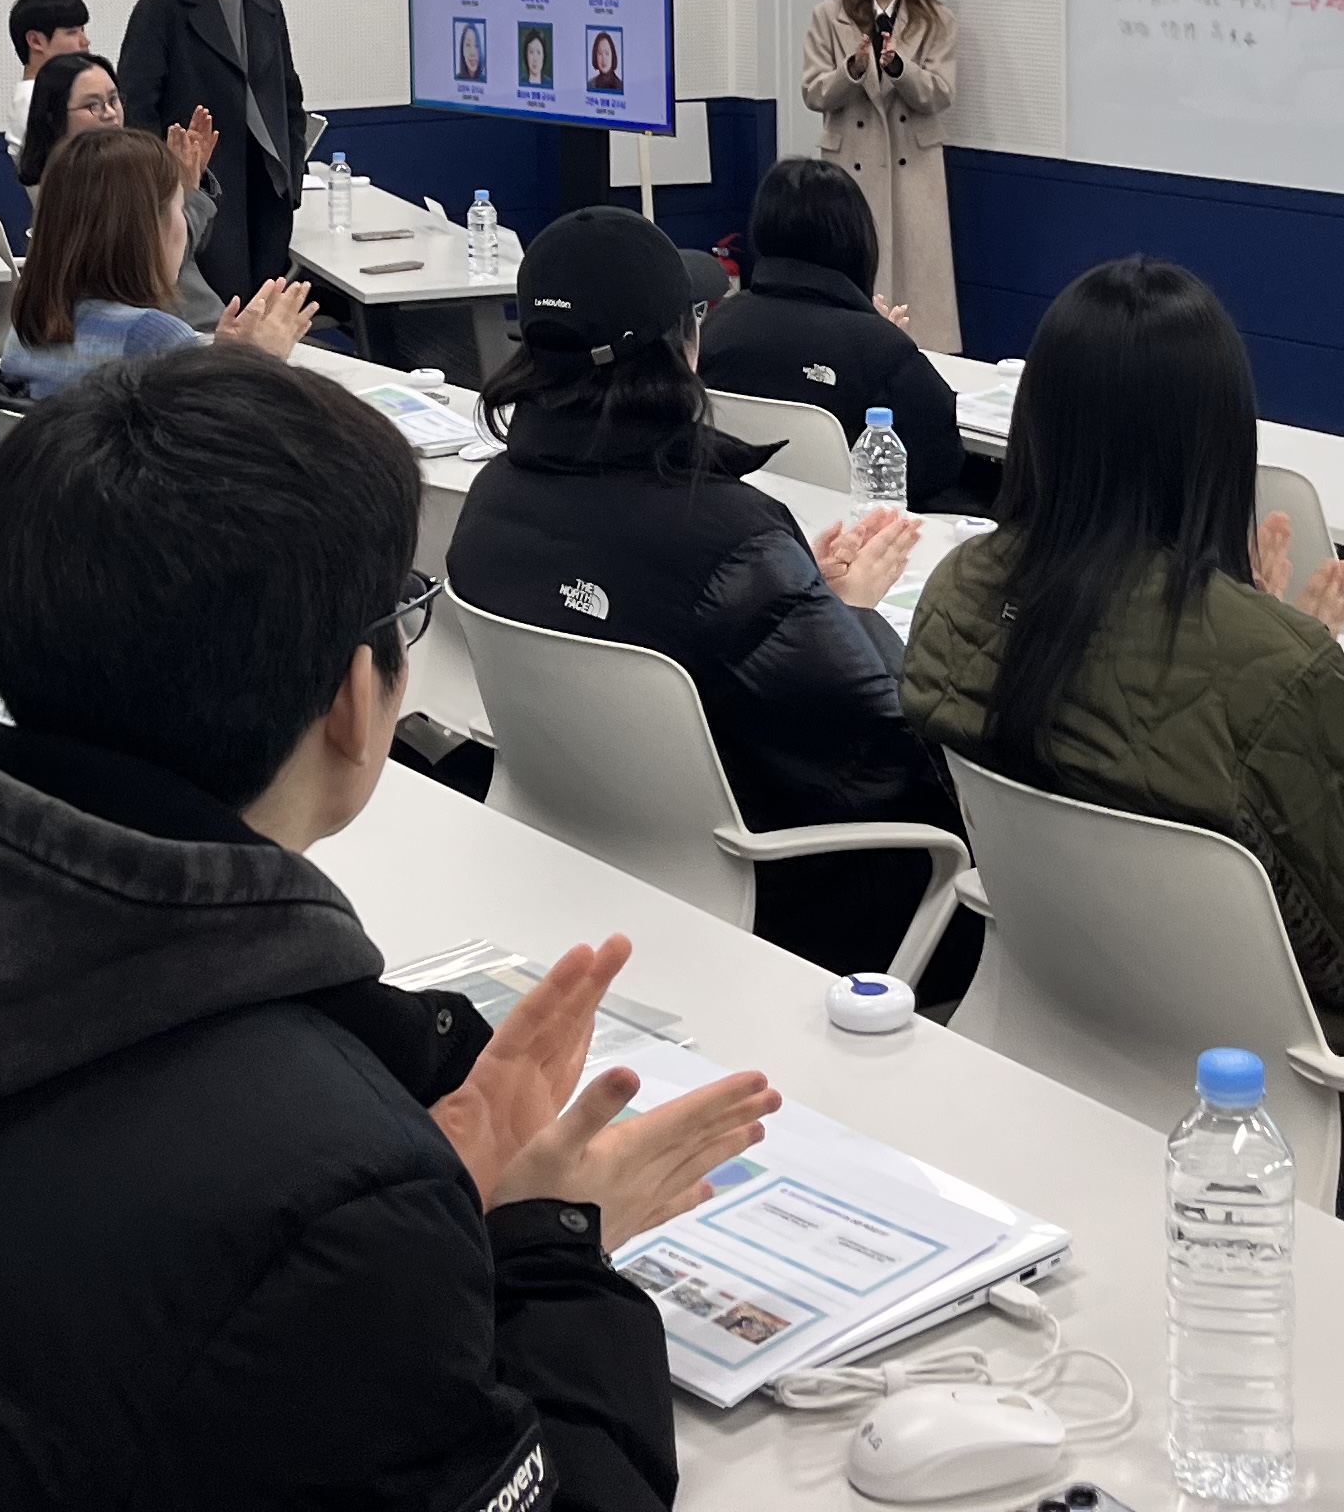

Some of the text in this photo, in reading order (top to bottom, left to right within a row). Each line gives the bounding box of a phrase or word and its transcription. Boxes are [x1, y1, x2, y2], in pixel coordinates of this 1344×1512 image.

[559, 583, 592, 603] NORTH
[575, 578, 594, 594] THE
[564, 595, 591, 614] FACE
